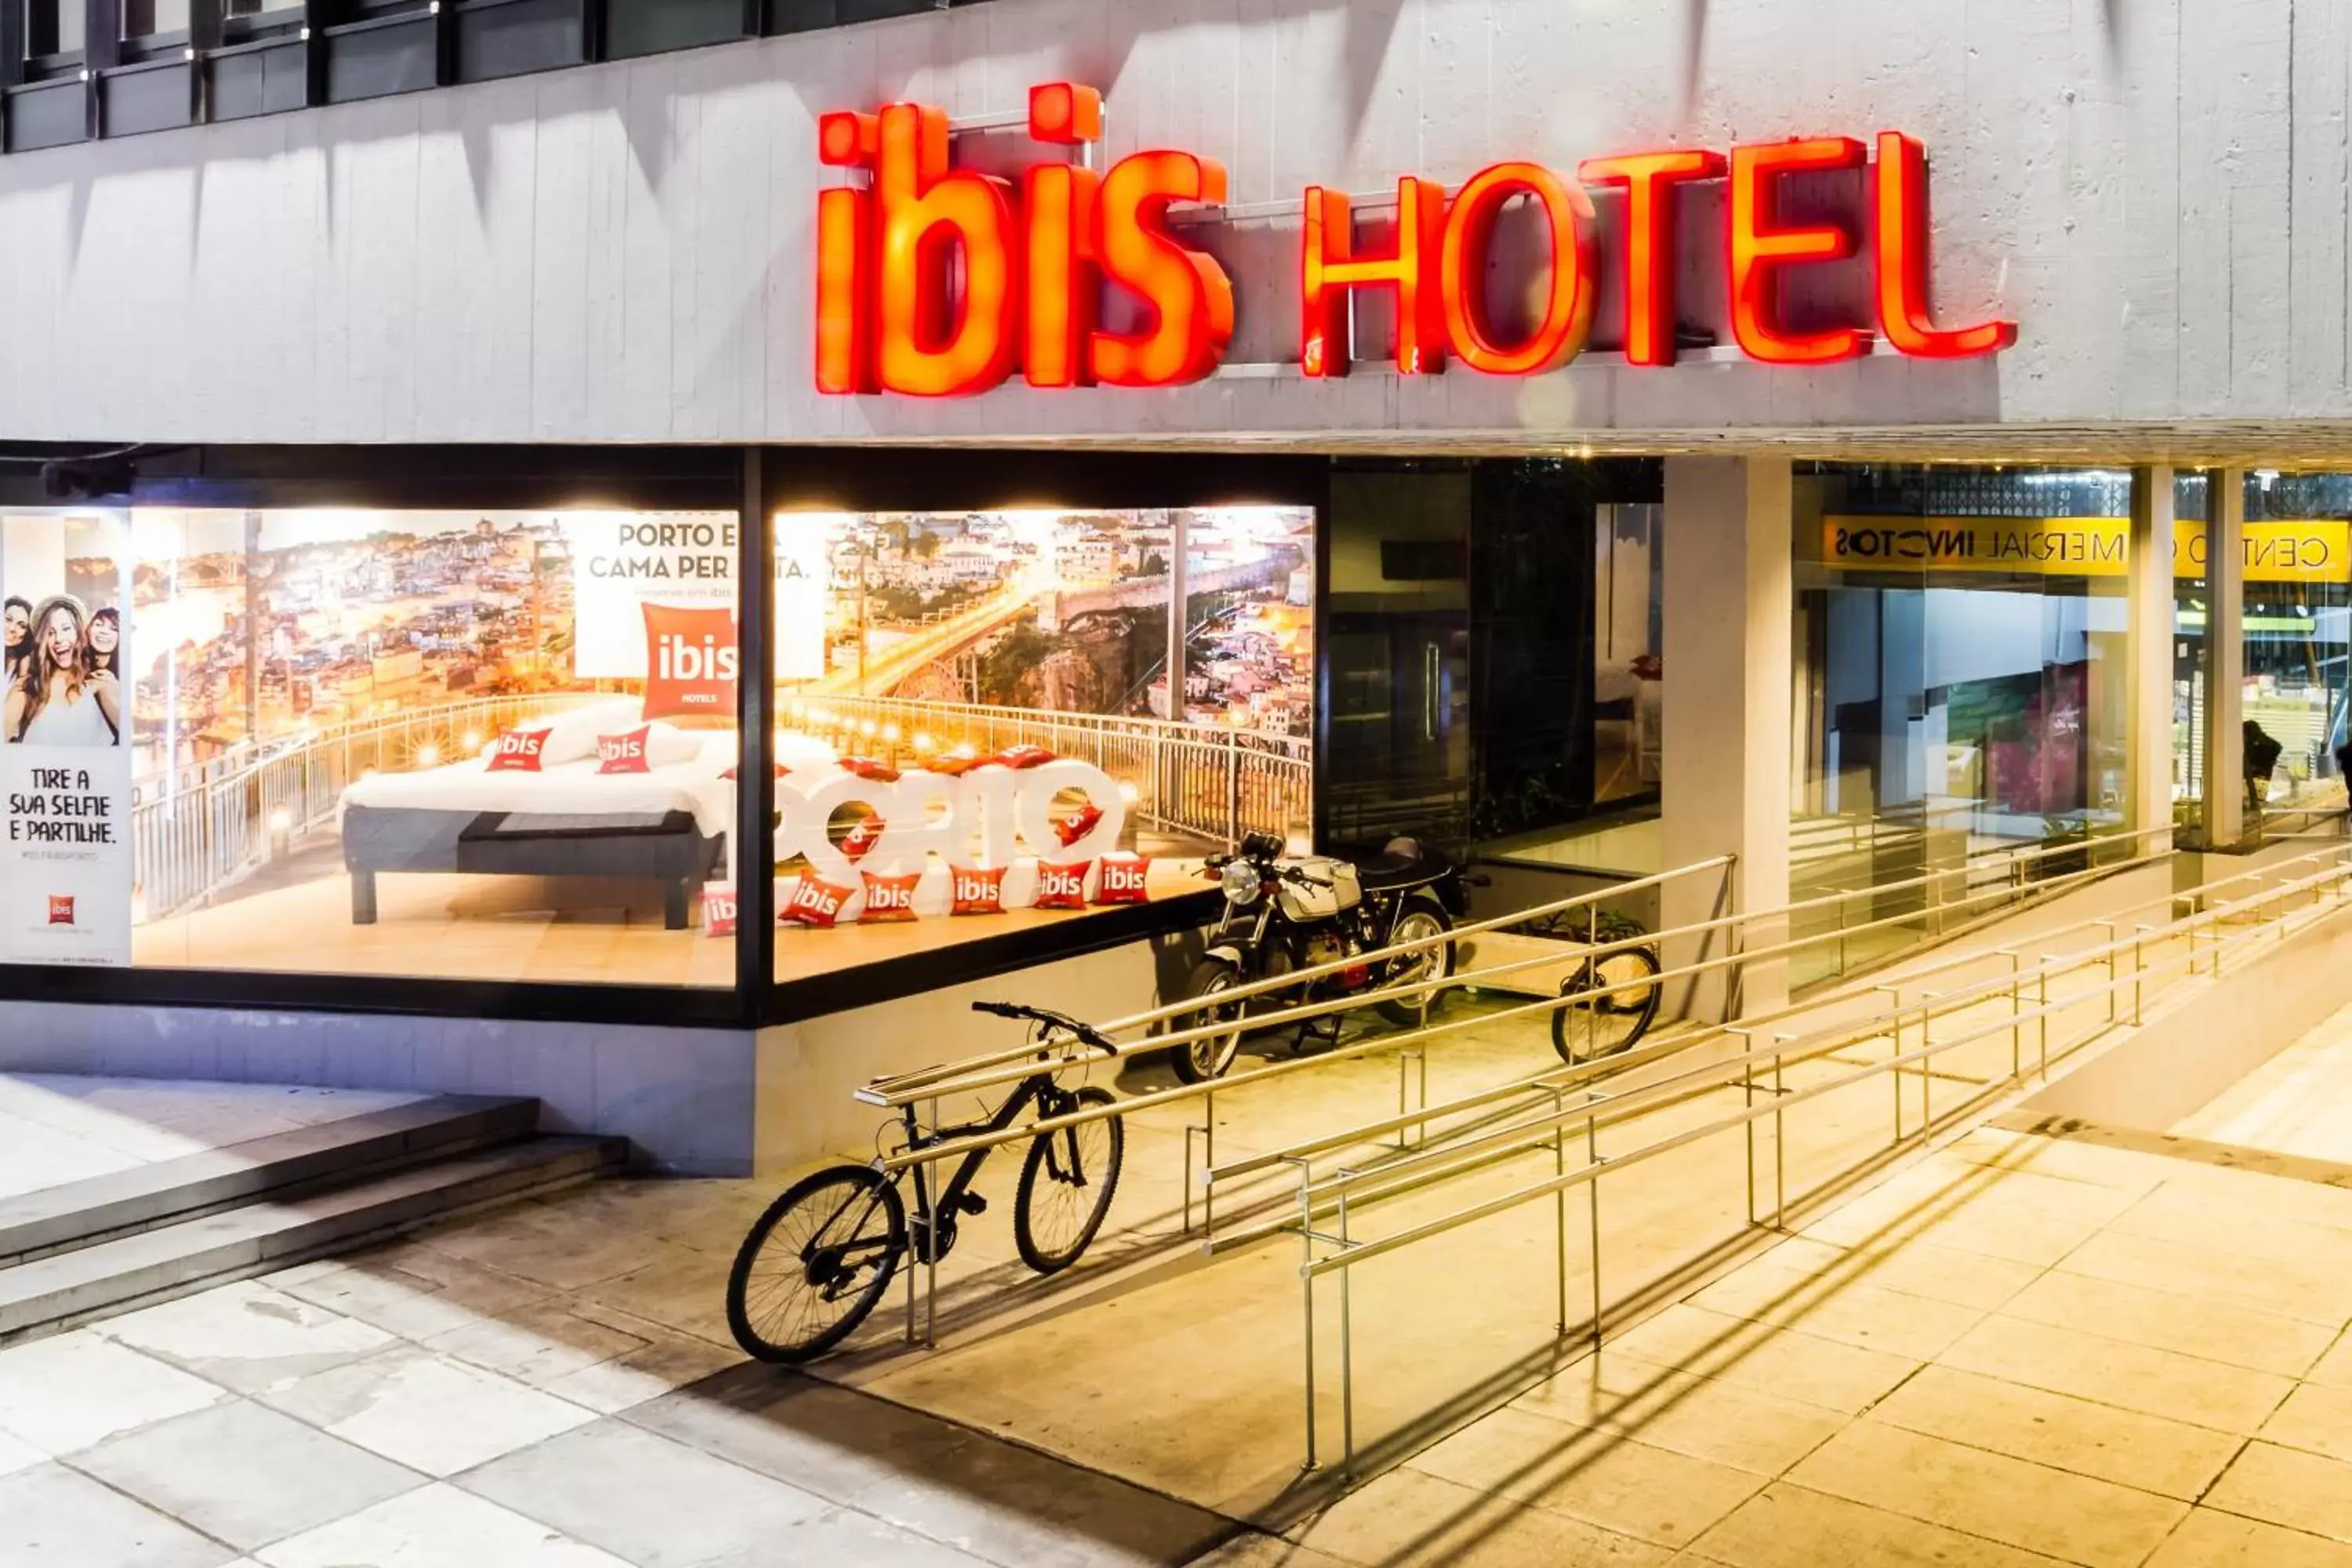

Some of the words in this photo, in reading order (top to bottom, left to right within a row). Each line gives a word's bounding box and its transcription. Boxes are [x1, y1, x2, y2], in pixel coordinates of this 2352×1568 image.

[815, 82, 1234, 398] ibis
[1301, 129, 2018, 377] HOTEL
[619, 523, 714, 547] PORTO
[589, 555, 671, 579] CAMA
[678, 554, 811, 579] PERTA.
[659, 634, 739, 681] ibis
[681, 694, 717, 703] HOTELS
[498, 734, 539, 755] ibis
[600, 737, 641, 760] ibis
[31, 768, 71, 789] TIRE
[77, 769, 90, 790] A
[9, 793, 46, 815] SUA
[51, 794, 111, 816] SELFIE
[9, 819, 21, 840] E
[27, 820, 117, 844] PARTILHE.
[956, 877, 999, 901] ibis
[1041, 870, 1080, 895] ibis
[1104, 866, 1145, 890] ibis
[793, 880, 839, 915] ibis
[868, 884, 912, 908] ibis
[710, 898, 737, 921] ib
